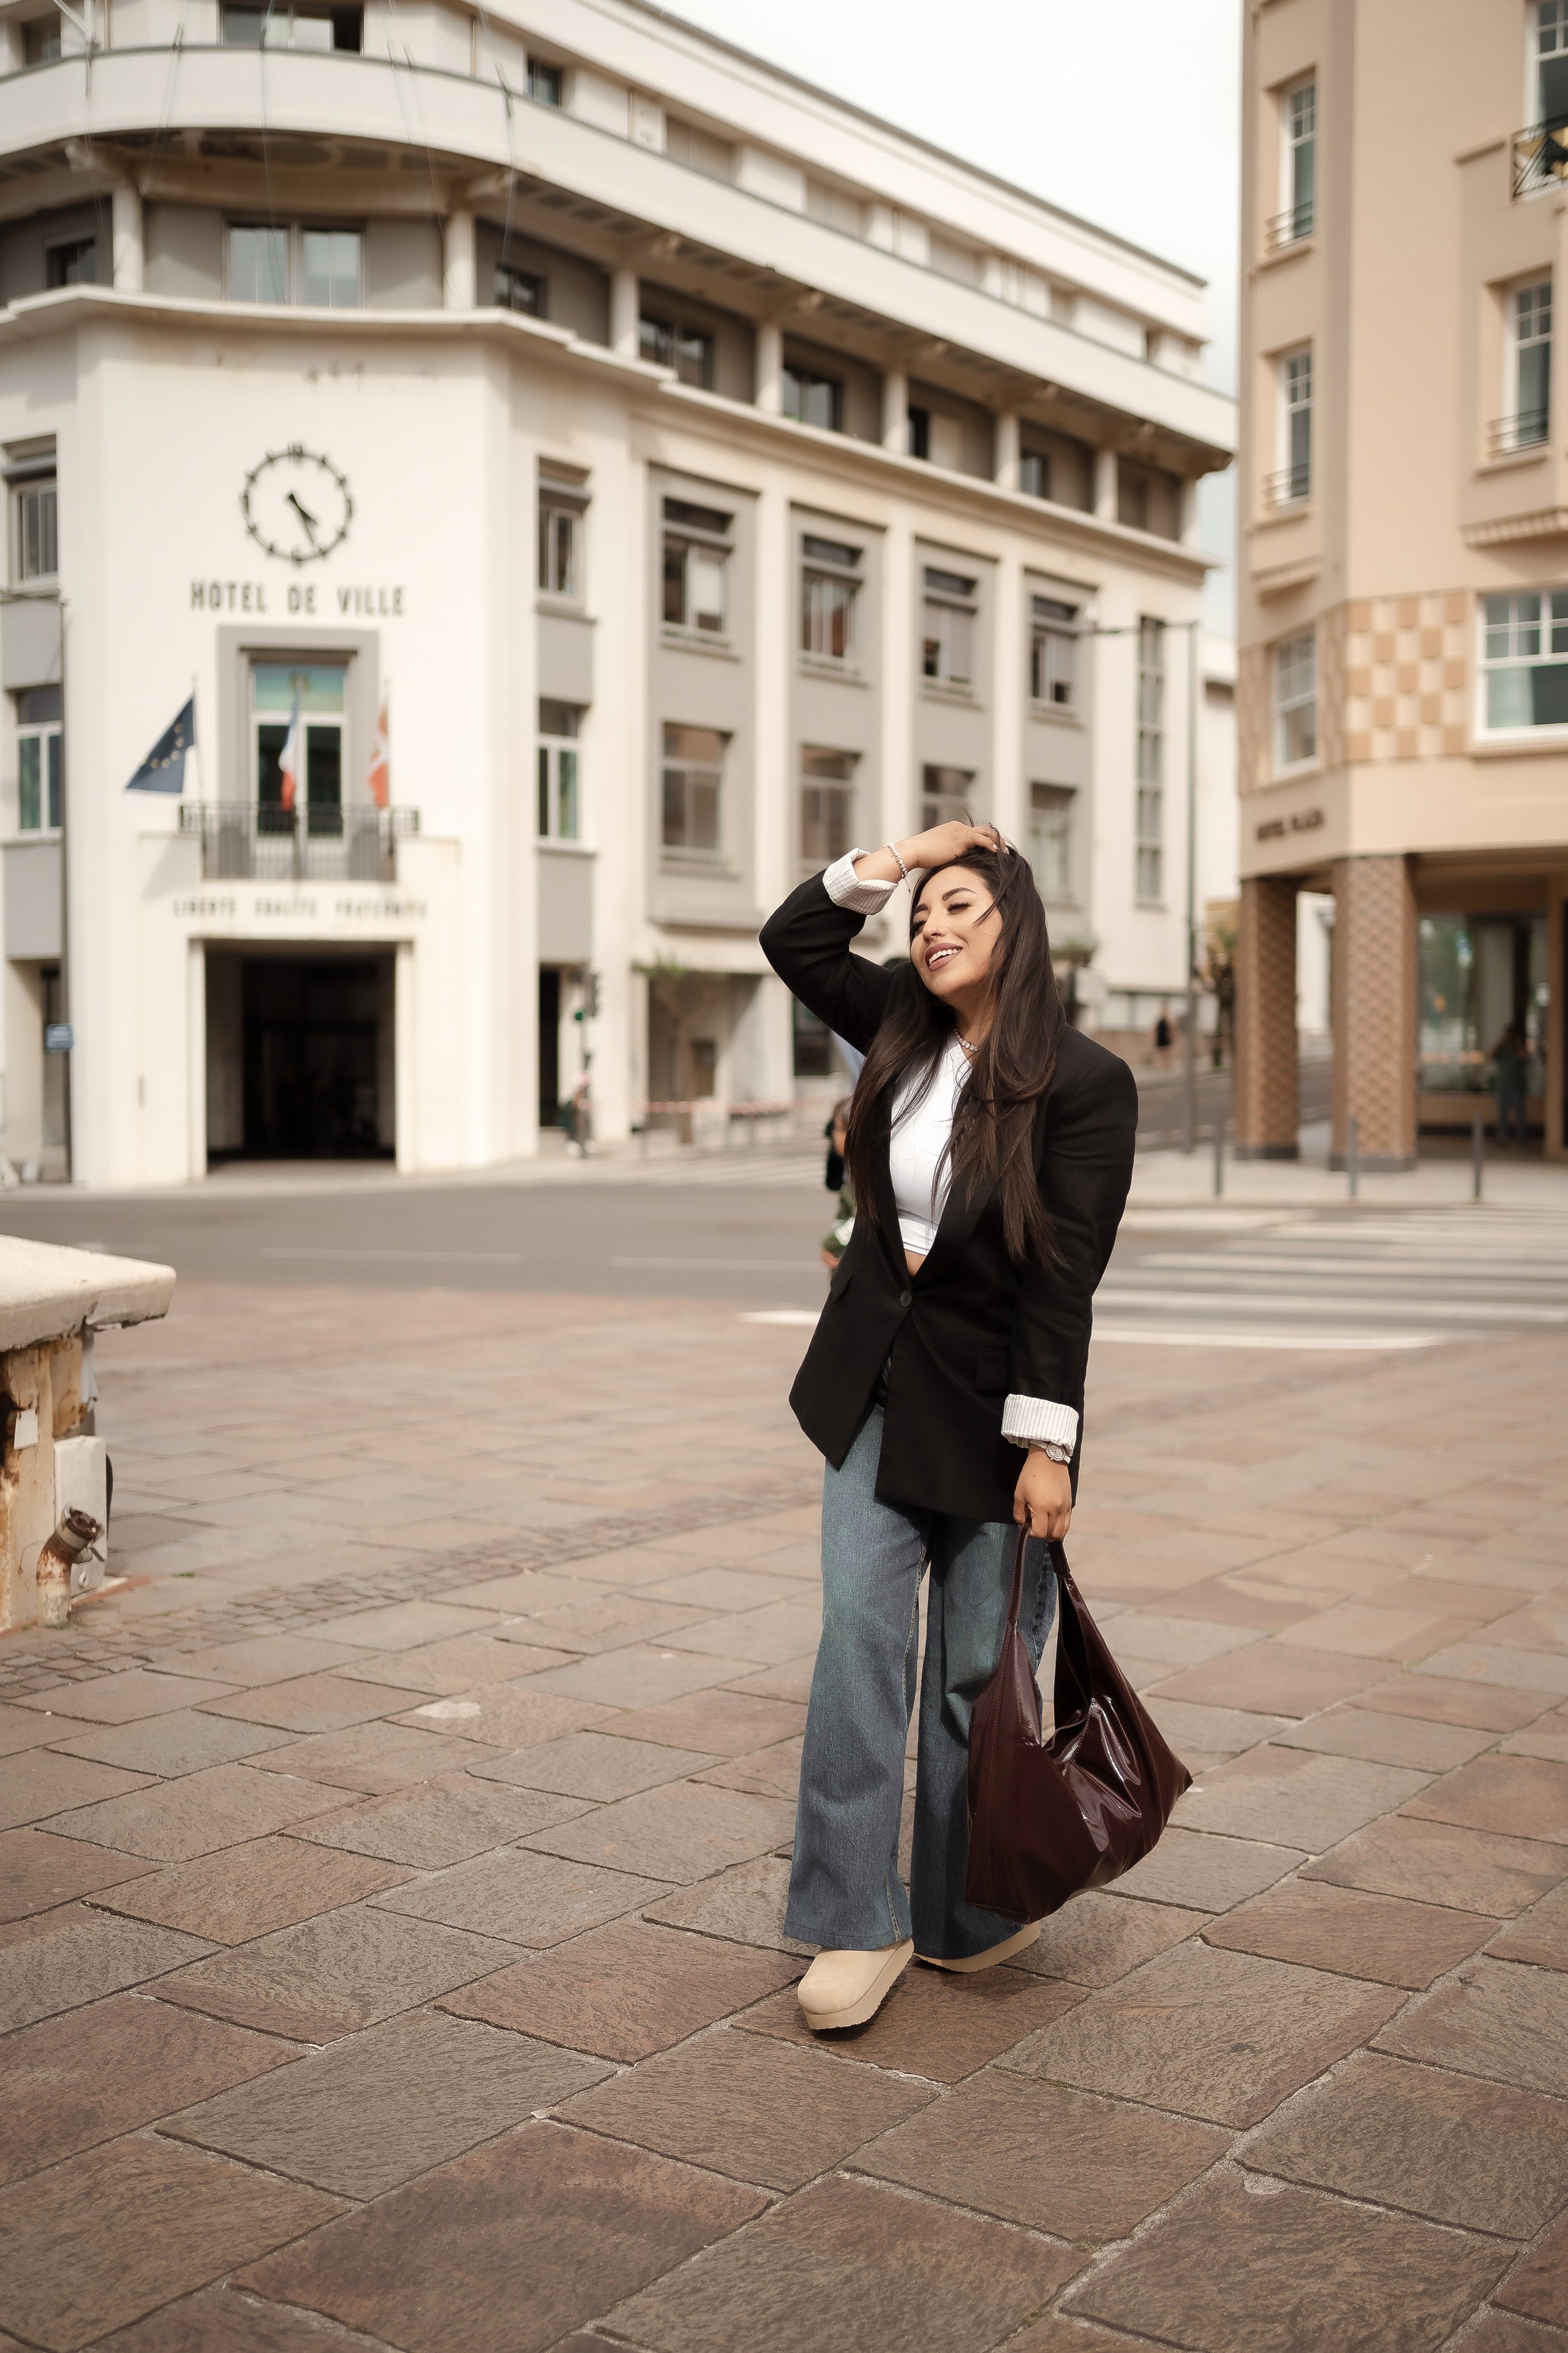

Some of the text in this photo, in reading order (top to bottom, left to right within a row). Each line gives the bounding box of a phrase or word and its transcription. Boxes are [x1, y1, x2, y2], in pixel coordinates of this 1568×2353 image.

[190, 581, 405, 616] HOTEL DE VILLE
